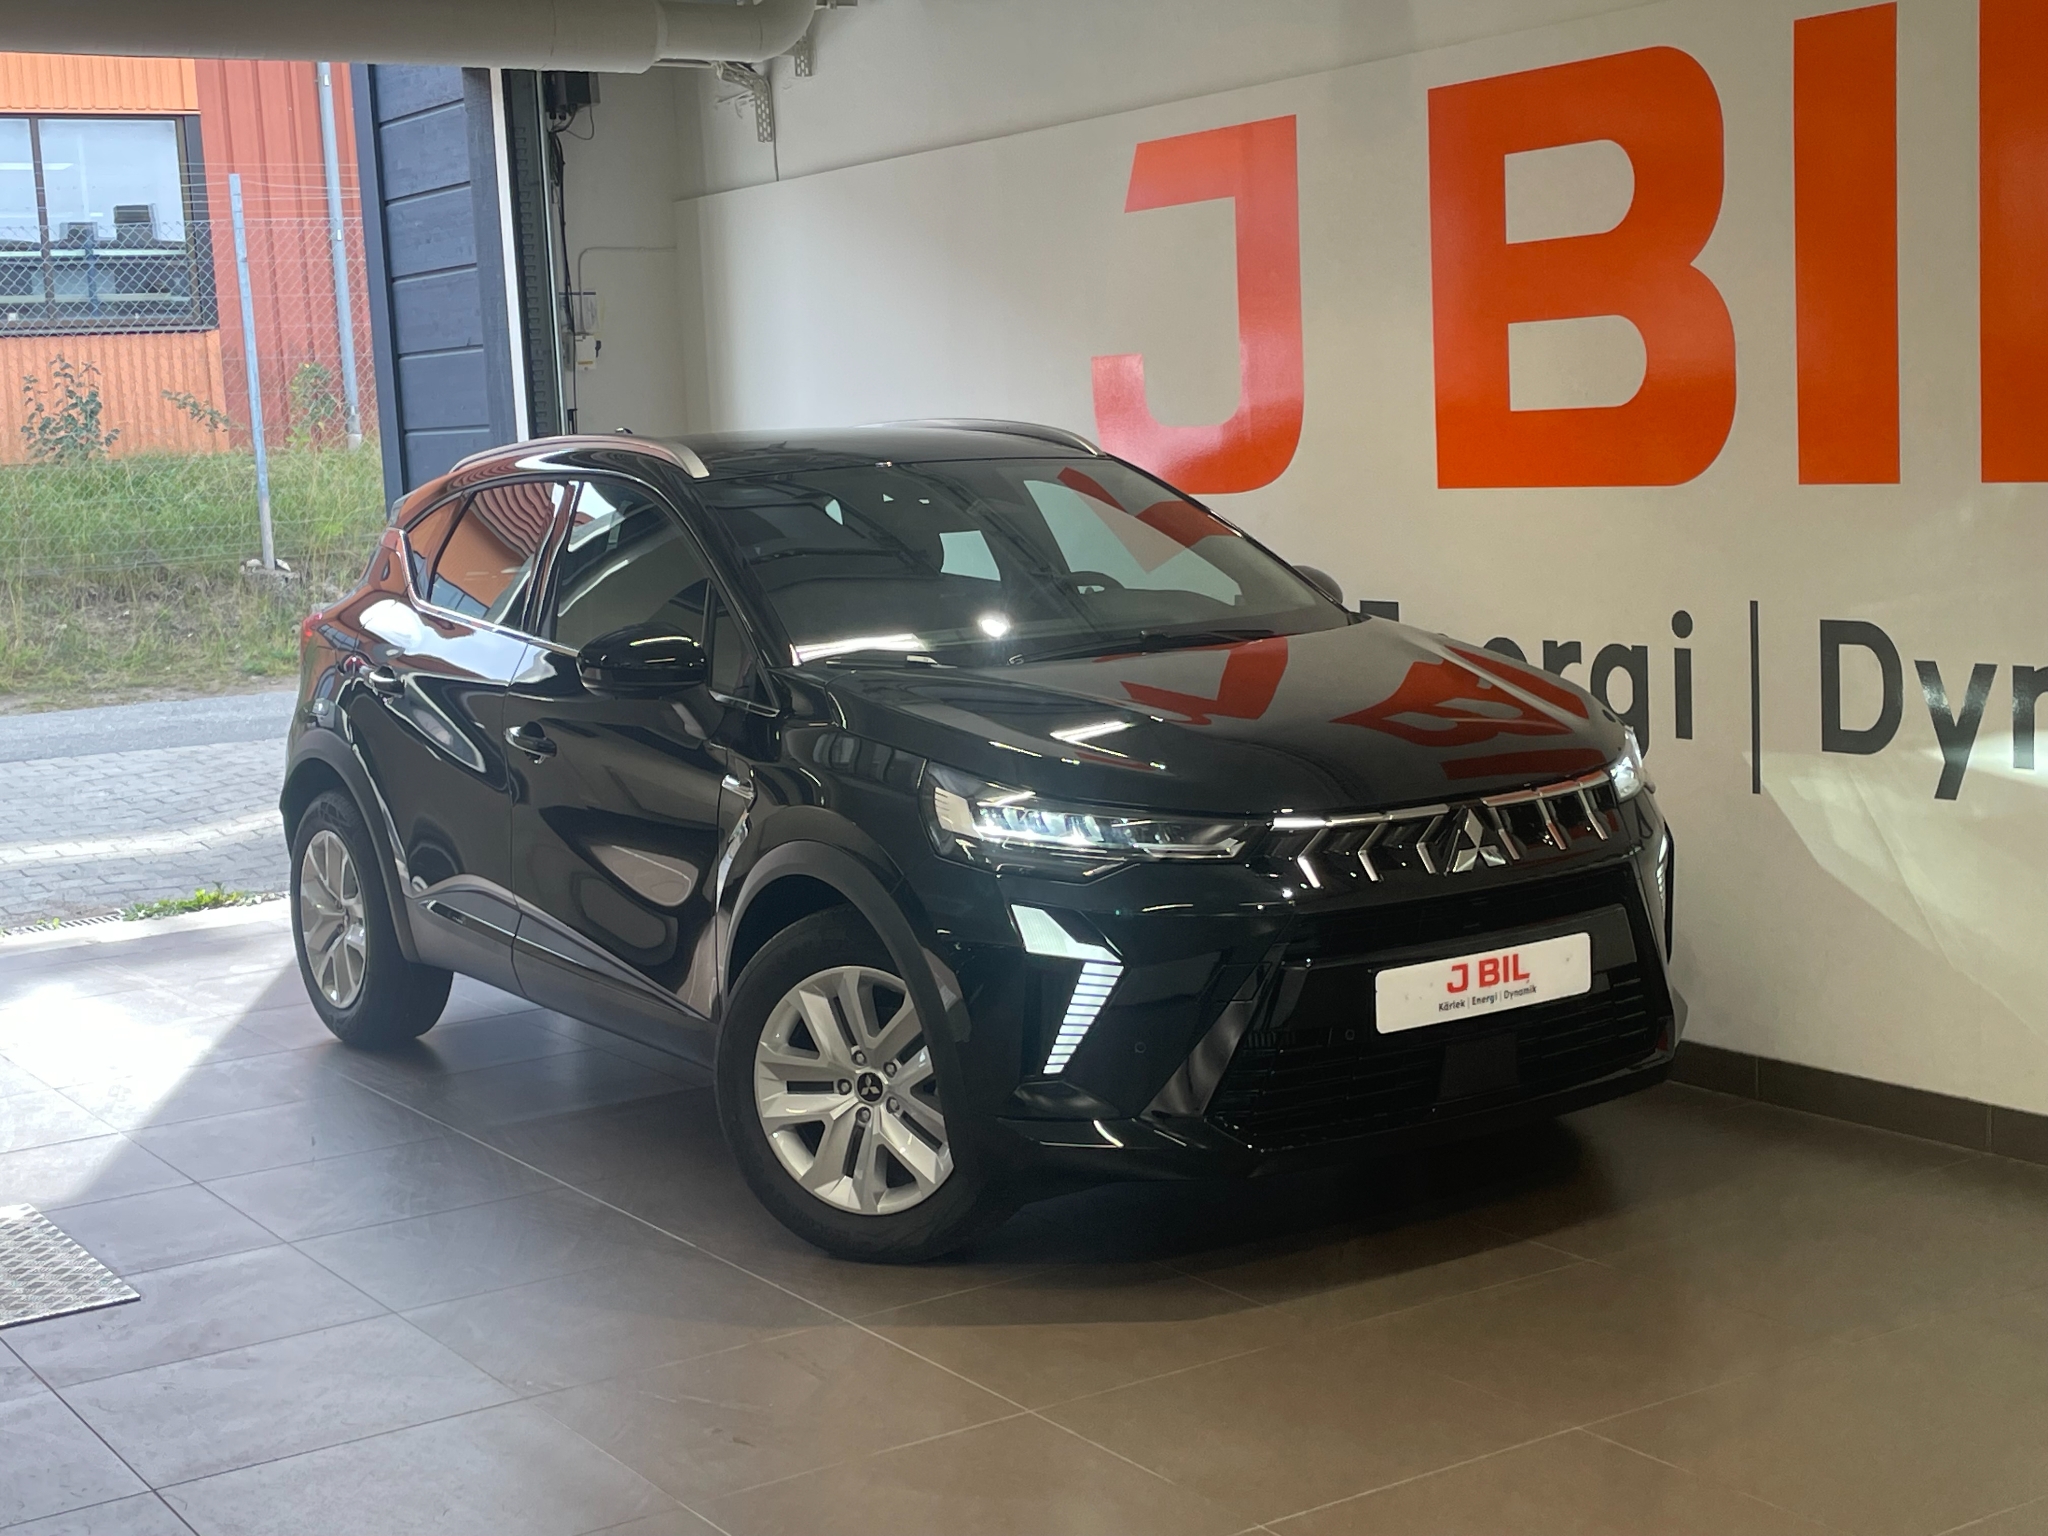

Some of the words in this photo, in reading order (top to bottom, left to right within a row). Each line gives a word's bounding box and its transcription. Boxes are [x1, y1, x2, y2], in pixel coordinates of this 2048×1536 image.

[1091, 114, 1304, 495] J
[1446, 963, 1469, 994] J
[1478, 953, 1530, 988] BIL
[1438, 999, 1466, 1012] Kärlek
[1471, 992, 1498, 1006] Energi
[1503, 985, 1537, 1000] Dynamik
